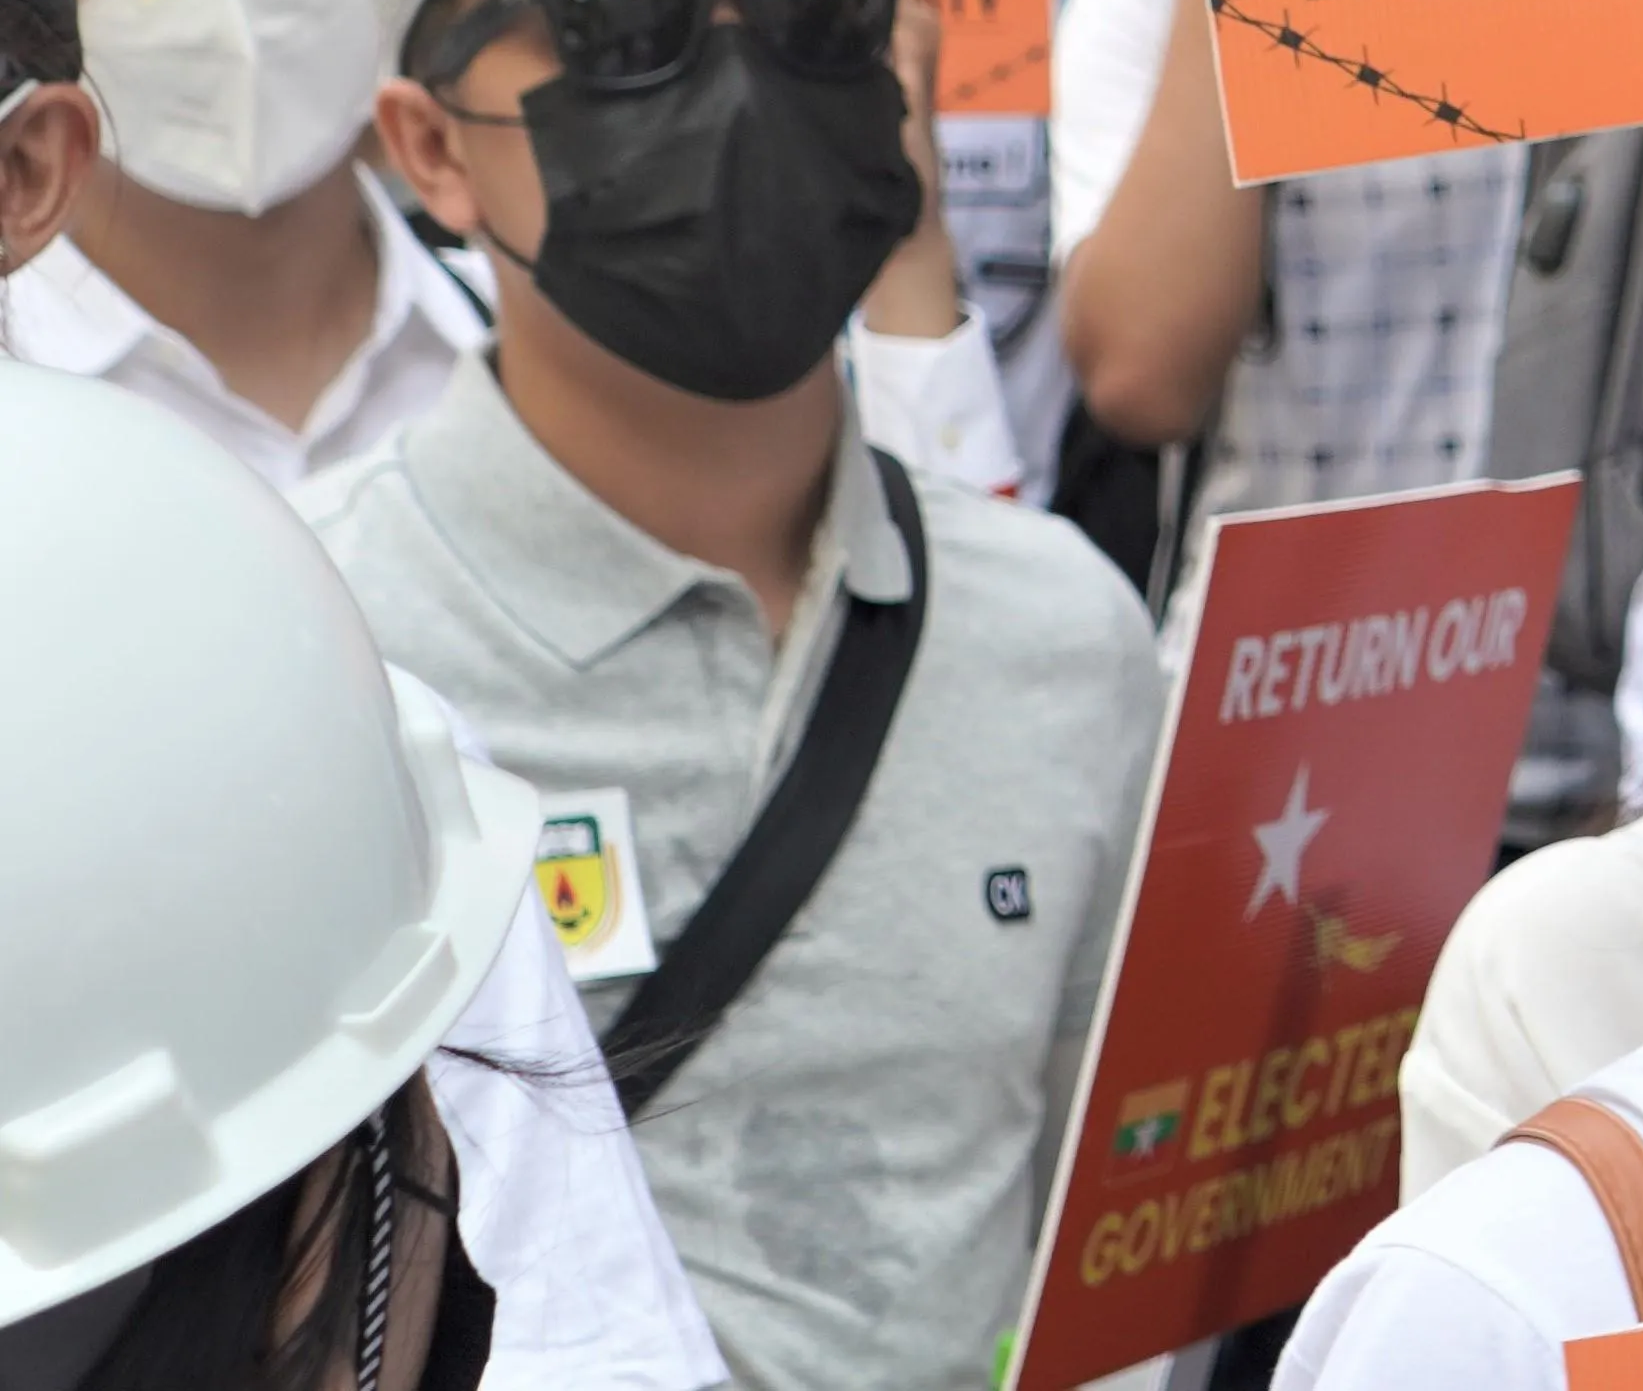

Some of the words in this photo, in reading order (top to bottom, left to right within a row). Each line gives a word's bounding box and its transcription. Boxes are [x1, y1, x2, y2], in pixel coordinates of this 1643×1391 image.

[1218, 608, 1429, 724] RETURN
[1426, 587, 1528, 683] OUR
[1079, 1116, 1399, 1288] GOVERNMENT
